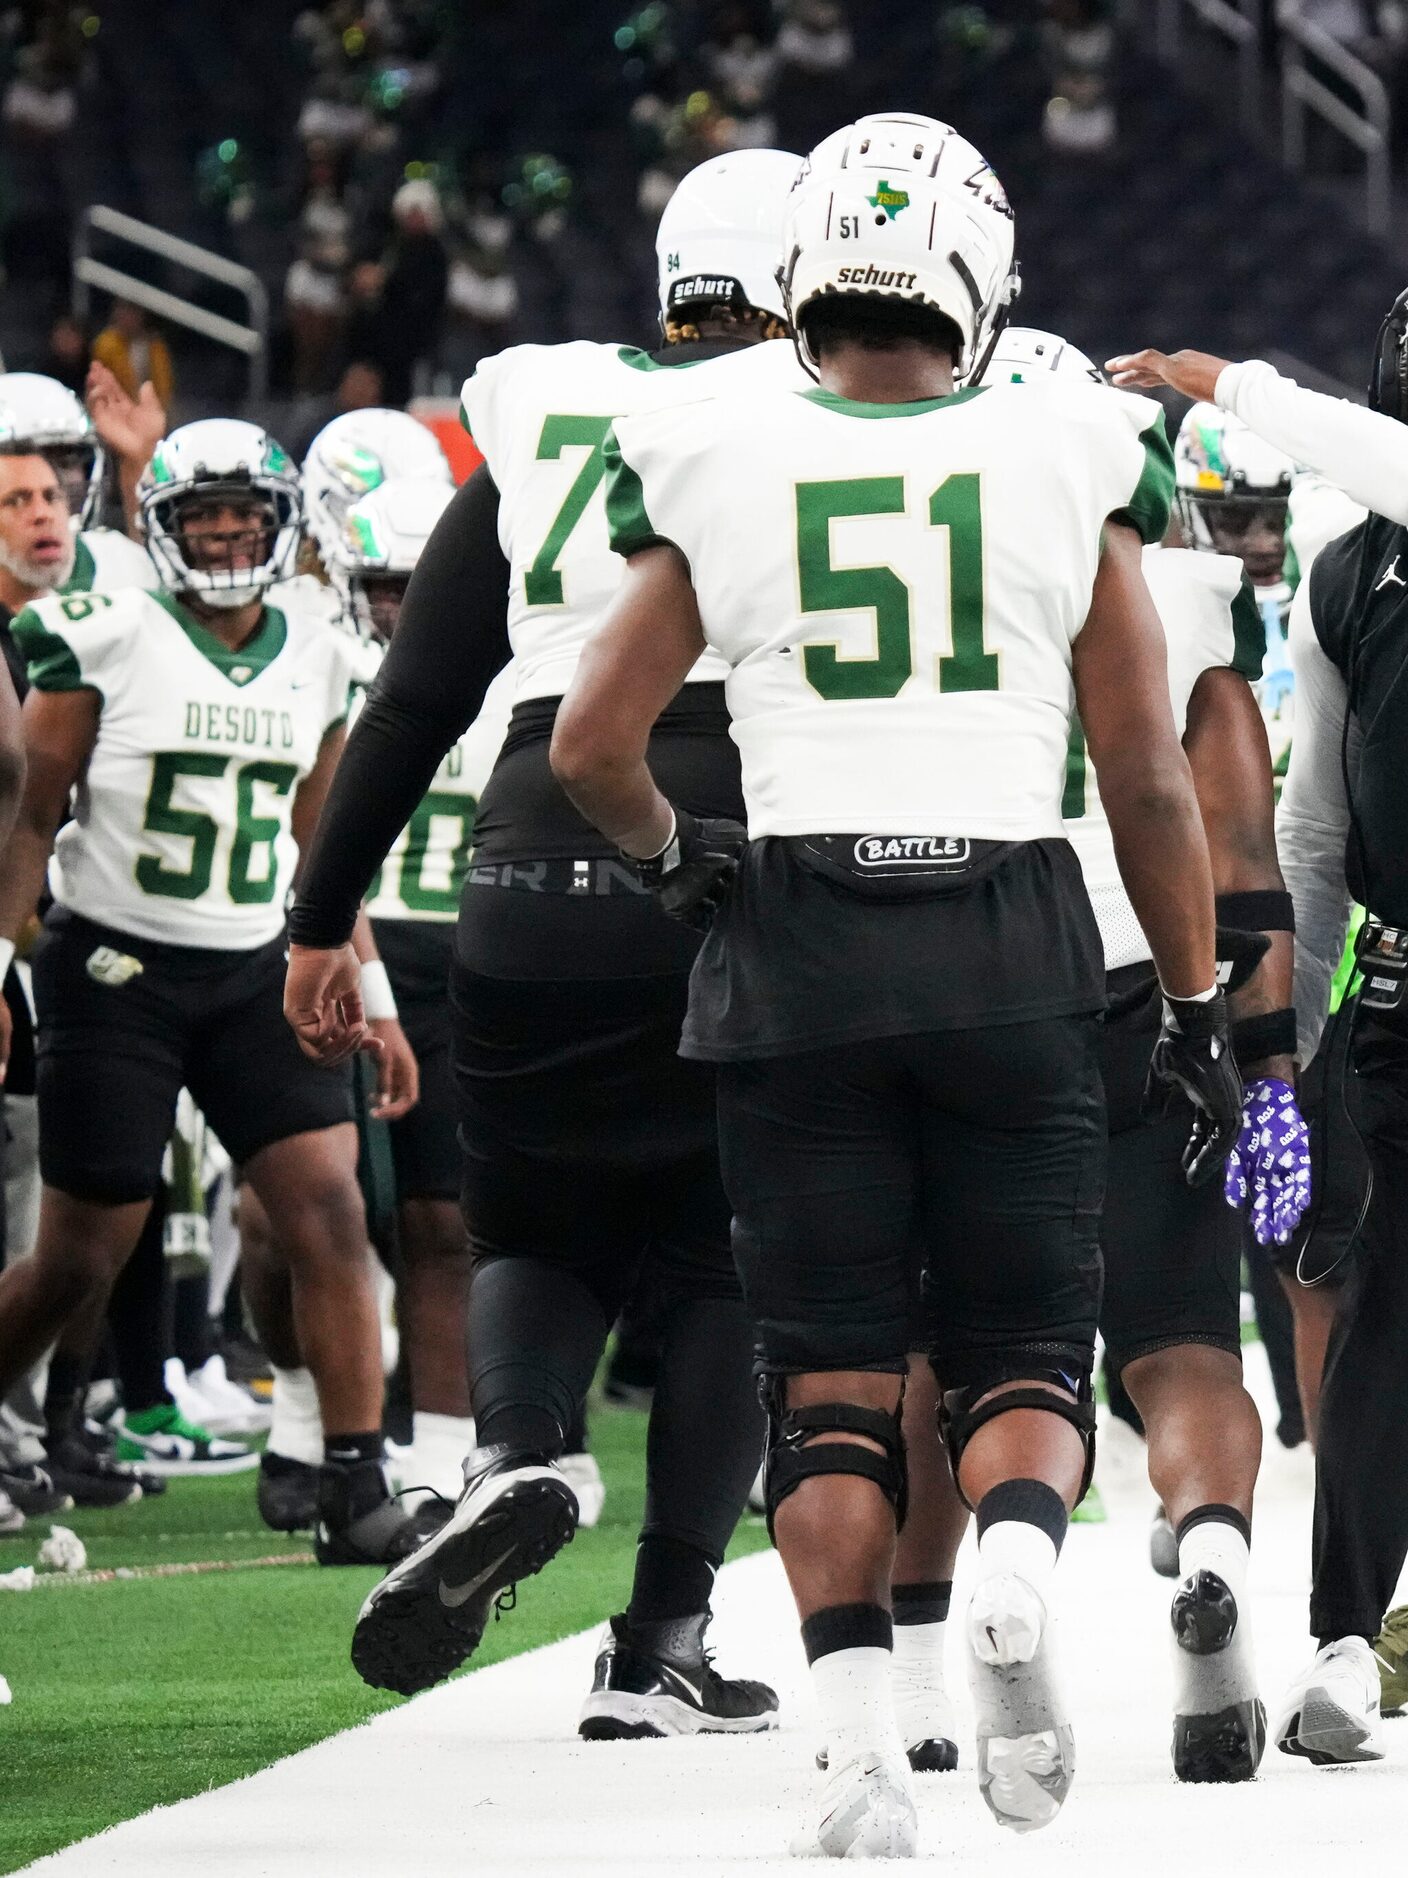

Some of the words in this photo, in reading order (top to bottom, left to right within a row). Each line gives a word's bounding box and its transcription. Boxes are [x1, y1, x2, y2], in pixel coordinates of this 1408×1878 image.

[840, 216, 859, 239] 51
[674, 276, 735, 299] schutt
[838, 263, 917, 290] schutt
[793, 472, 1001, 701] 51
[184, 702, 294, 748] DESOTO
[133, 751, 300, 904] 56
[864, 836, 960, 860] BATTLE
[1256, 1105, 1276, 1125] TCU
[1279, 1127, 1299, 1146] TCU
